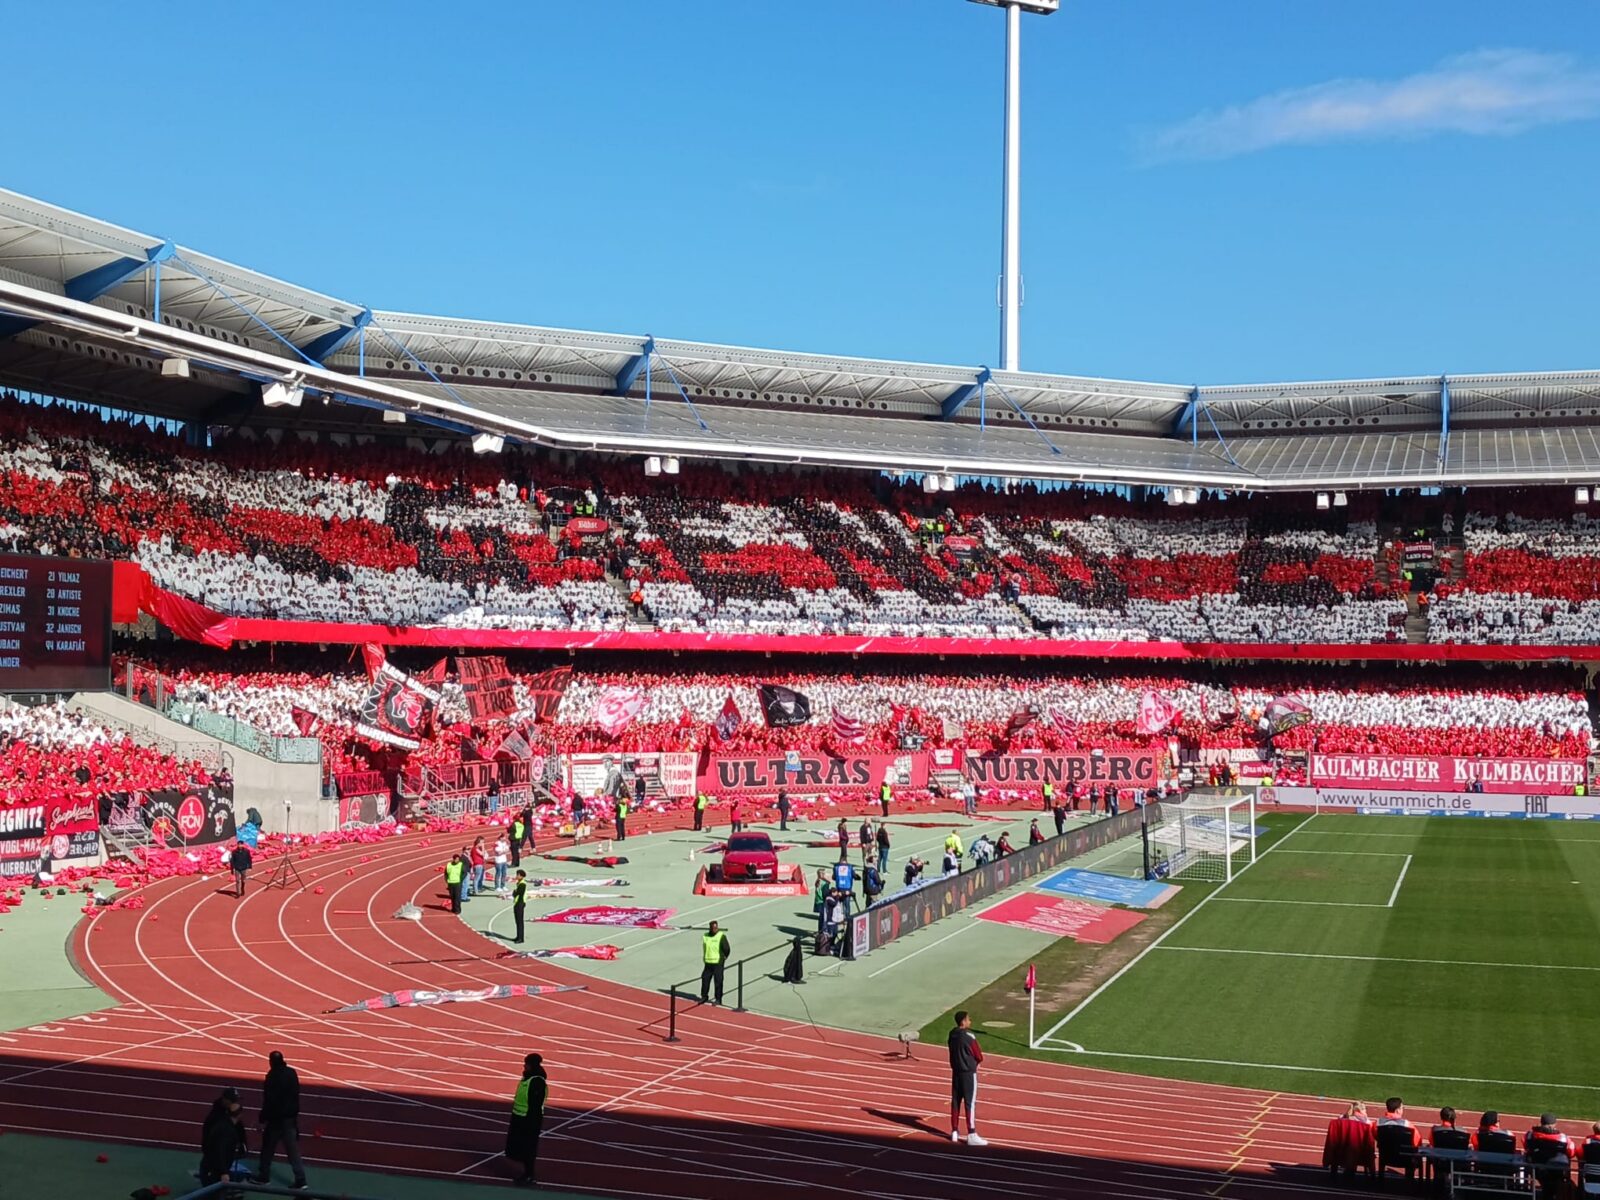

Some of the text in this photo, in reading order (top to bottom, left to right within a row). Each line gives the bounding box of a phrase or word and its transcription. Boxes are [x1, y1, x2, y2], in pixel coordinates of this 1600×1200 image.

[58, 572, 80, 583] YILMAZ
[718, 759, 870, 787] ULTRAS
[1312, 755, 1440, 779] KULMBACHER
[1453, 759, 1584, 783] KULMBACHER
[187, 802, 194, 814] 1
[1322, 792, 1471, 809] www.kummich.de
[1525, 795, 1550, 814] FIAT
[0, 806, 44, 832] EGNITZ
[181, 815, 200, 829] FCN
